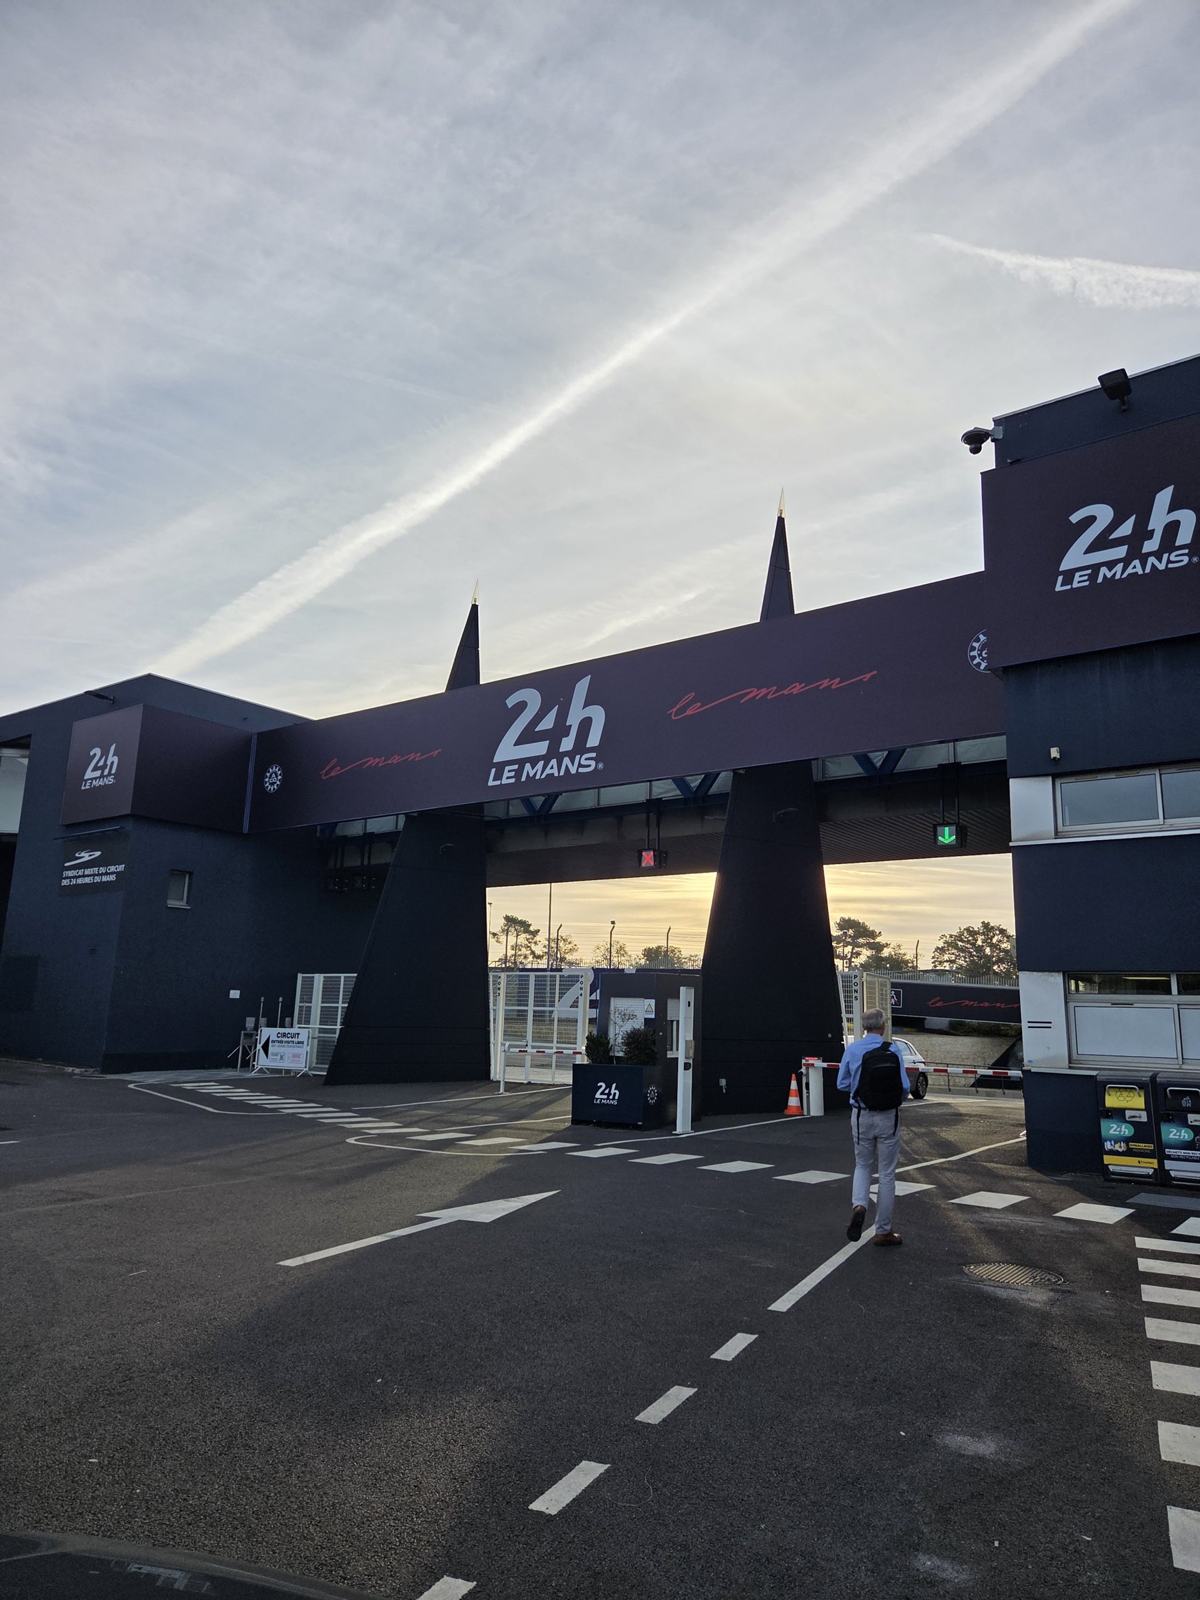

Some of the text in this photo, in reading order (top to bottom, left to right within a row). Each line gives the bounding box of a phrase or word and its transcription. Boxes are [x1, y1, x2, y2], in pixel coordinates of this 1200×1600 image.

[1059, 484, 1197, 571] 24h
[1055, 569, 1092, 592] LE
[492, 674, 606, 763] 24h
[84, 743, 119, 780] 24h
[487, 764, 519, 787] LE
[81, 780, 92, 790] LE
[62, 868, 84, 878] SYNDICAT
[99, 866, 107, 874] DU
[106, 864, 125, 873] CIRCUIT
[93, 875, 102, 883] DU
[101, 873, 117, 882] MANS
[276, 1031, 300, 1039] CIRCUIT
[595, 1082, 620, 1100] 24h
[1108, 1123, 1129, 1136] 24h
[1168, 1128, 1189, 1140] 24h
